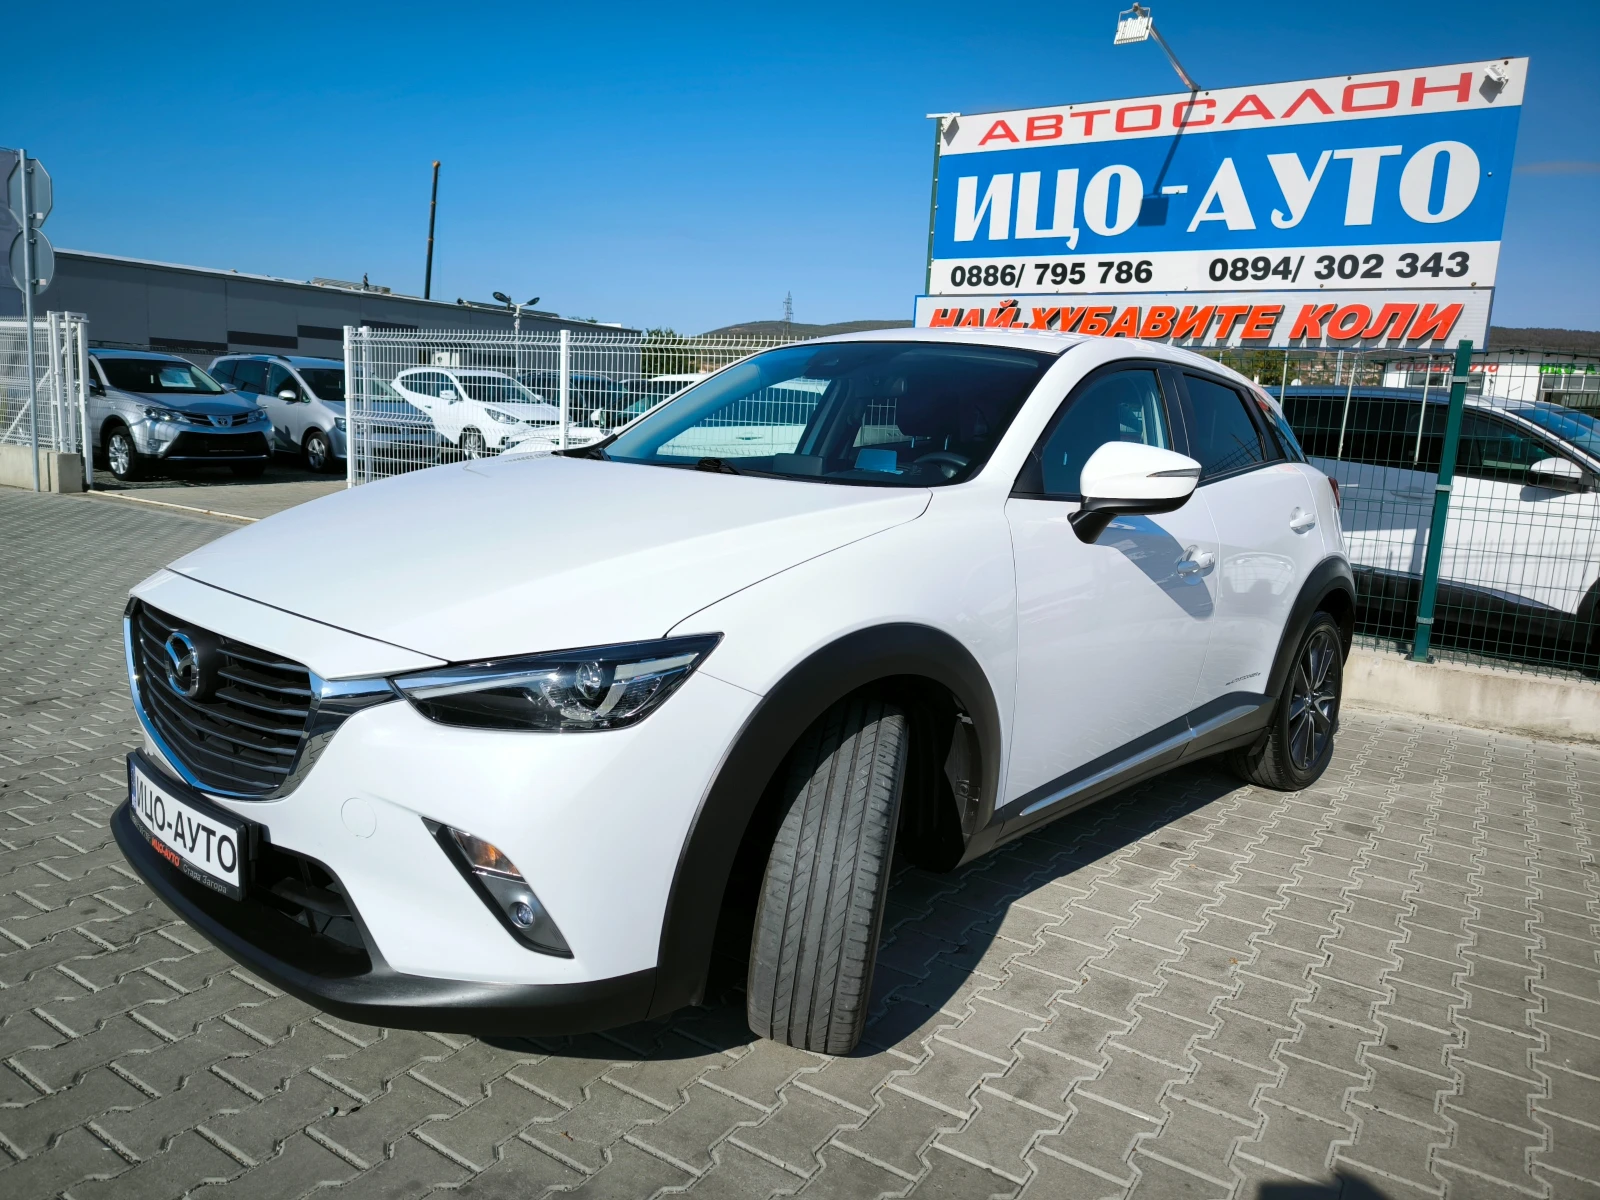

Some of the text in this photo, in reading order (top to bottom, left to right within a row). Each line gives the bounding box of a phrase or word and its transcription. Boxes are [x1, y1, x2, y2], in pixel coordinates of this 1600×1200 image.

[978, 71, 1473, 146] АВТОСАЛОН
[953, 140, 1481, 250] ИЦО-АУТО
[950, 260, 1154, 288] 0886/ 795 786
[1208, 251, 1470, 283] 0894/ 302 343
[1288, 302, 1464, 340] КОЛИ
[136, 775, 237, 873] ИЦО-АУТО
[182, 863, 202, 882] Стара
[202, 874, 228, 895] Загора
